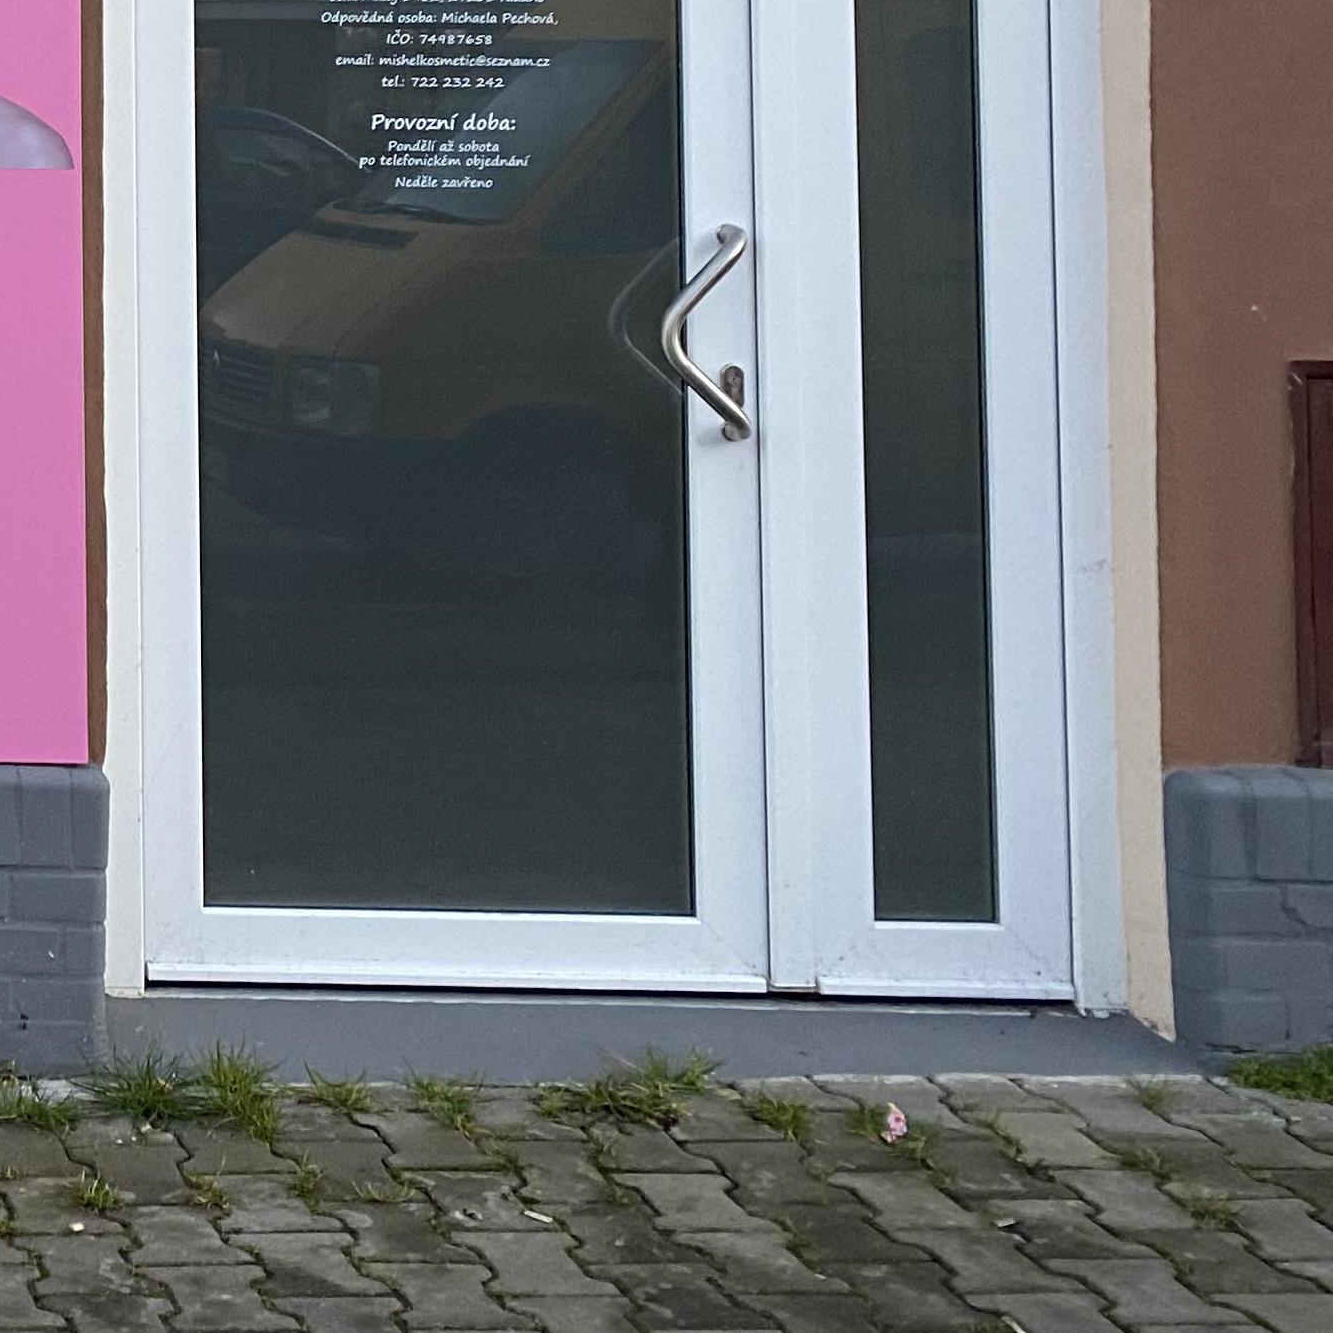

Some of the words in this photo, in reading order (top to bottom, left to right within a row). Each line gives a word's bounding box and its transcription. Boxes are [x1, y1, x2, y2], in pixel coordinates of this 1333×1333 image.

[321, 10, 394, 27] Odpovědná
[440, 11, 498, 24] Michaela
[335, 53, 375, 66] email:
[411, 76, 439, 88] 722
[442, 77, 472, 88] 232
[475, 77, 505, 88] 242
[371, 112, 459, 131] Provozní
[462, 112, 516, 131] doba:
[387, 139, 437, 152] Pondělí
[438, 139, 455, 152] až
[458, 139, 500, 153] sobota
[358, 156, 376, 170] po
[380, 153, 462, 167] telefonickém
[465, 154, 531, 170] objednání
[394, 174, 438, 188] Neděle
[441, 176, 493, 188] zavřeno
